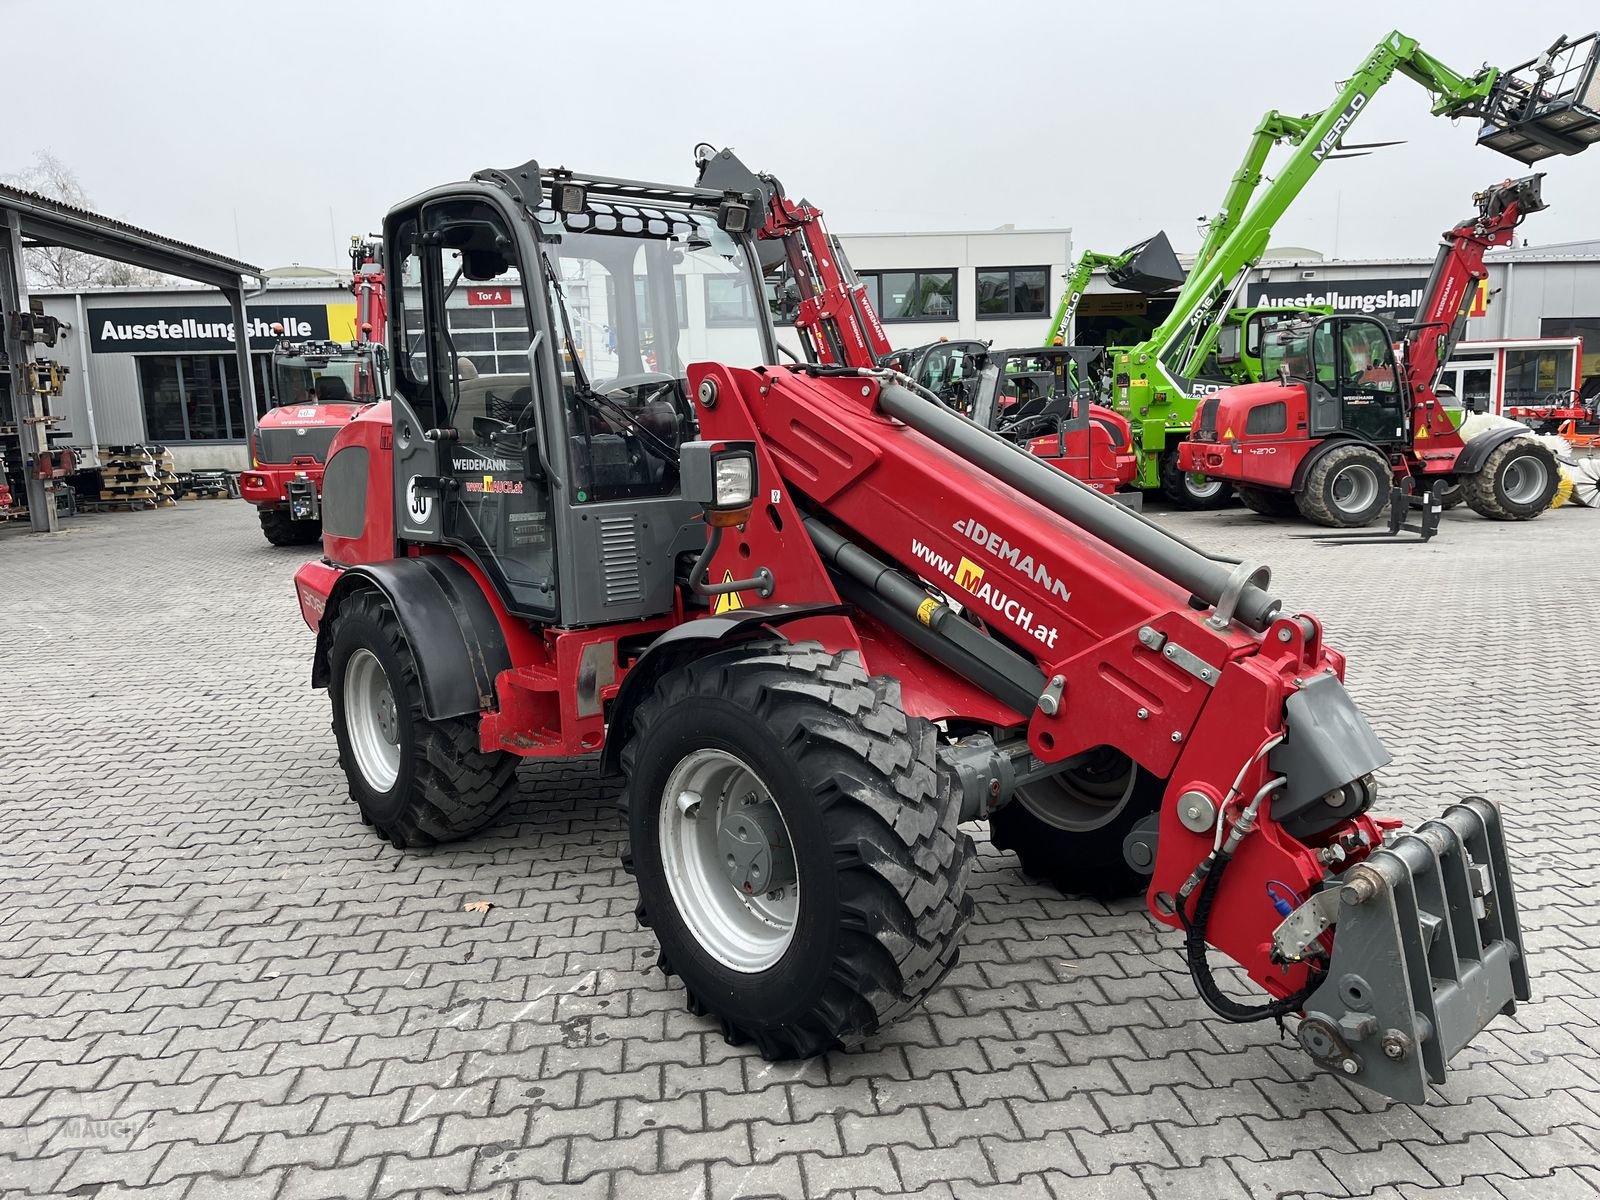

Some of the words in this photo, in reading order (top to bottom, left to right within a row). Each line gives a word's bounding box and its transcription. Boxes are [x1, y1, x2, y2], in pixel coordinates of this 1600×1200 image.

[1312, 93, 1366, 161] MERLO
[476, 291, 493, 301] Tor
[494, 291, 502, 300] A
[1257, 289, 1424, 313] Ausstellungshall
[861, 296, 885, 342] WEIDEMANN
[1057, 292, 1080, 337] MERLO
[1190, 297, 1214, 327] 40.16
[848, 314, 864, 349] WEIDEMANN
[452, 458, 507, 471] WEIDEMANN
[1249, 447, 1277, 455] 4270
[465, 478, 523, 494] www.MAUCH.at
[911, 538, 1059, 649] www.MAUCH.at
